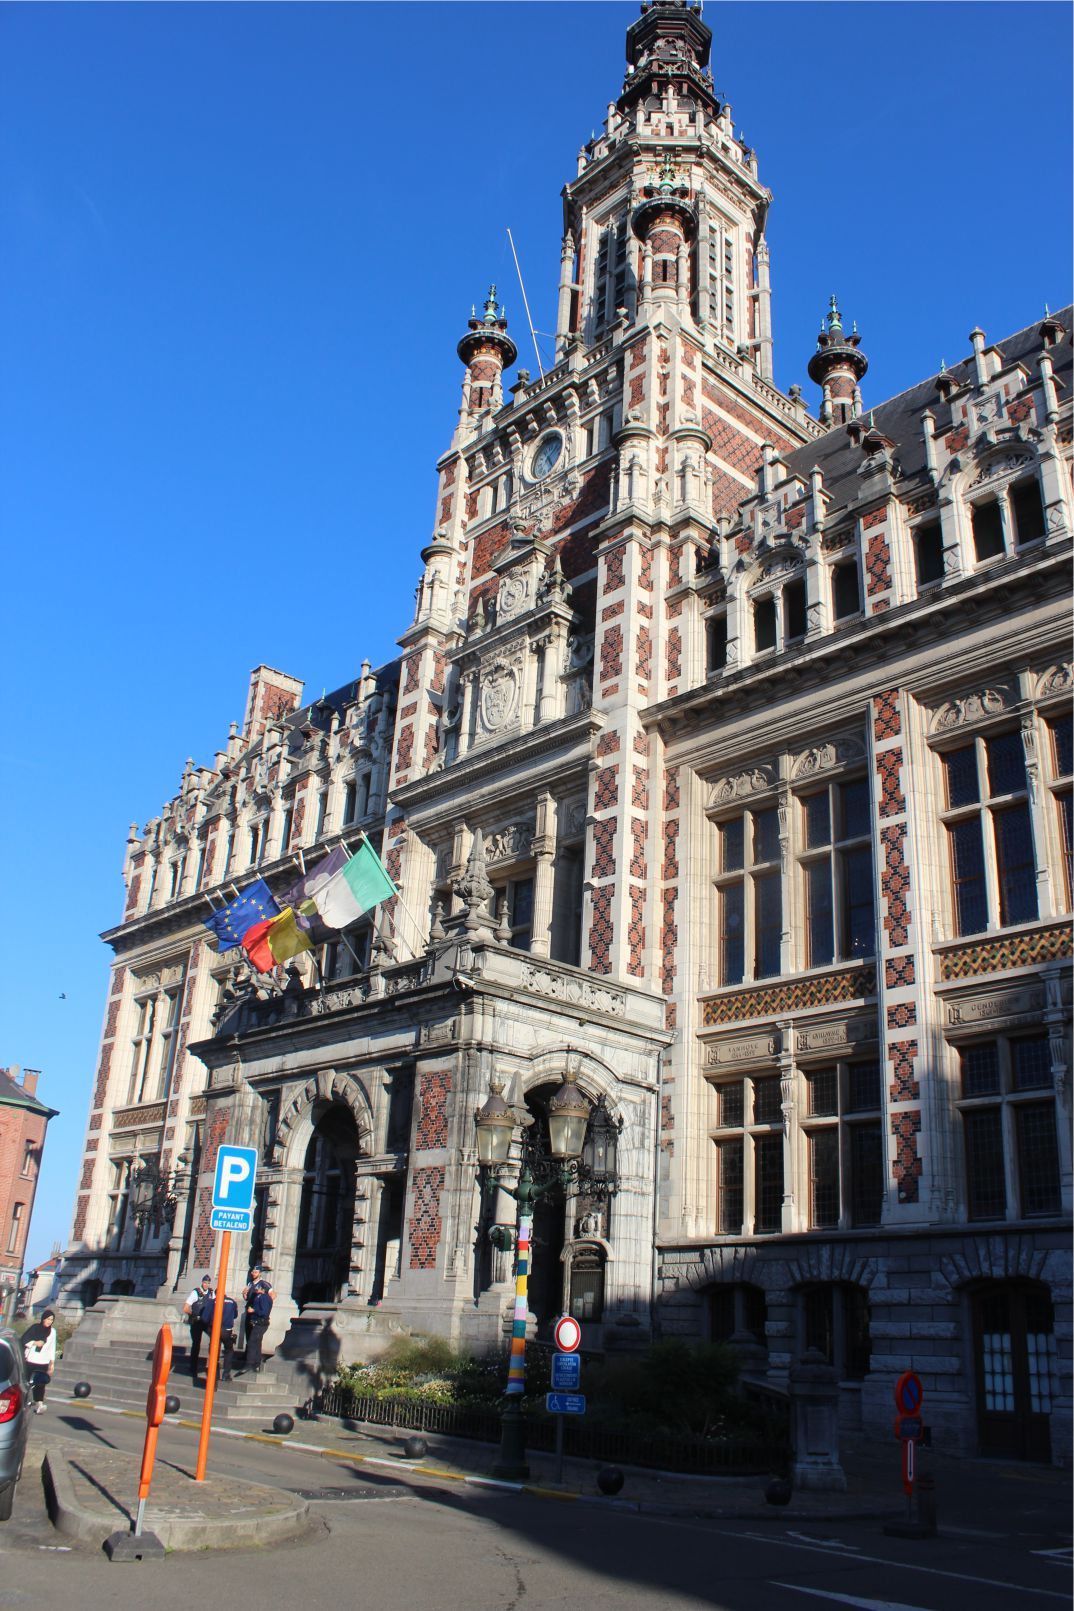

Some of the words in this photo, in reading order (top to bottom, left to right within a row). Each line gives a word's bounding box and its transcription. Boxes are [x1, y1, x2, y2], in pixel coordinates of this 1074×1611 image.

[219, 1155, 250, 1199] P
[218, 1212, 244, 1221] PAYANT
[213, 1220, 247, 1230] BETALEND
